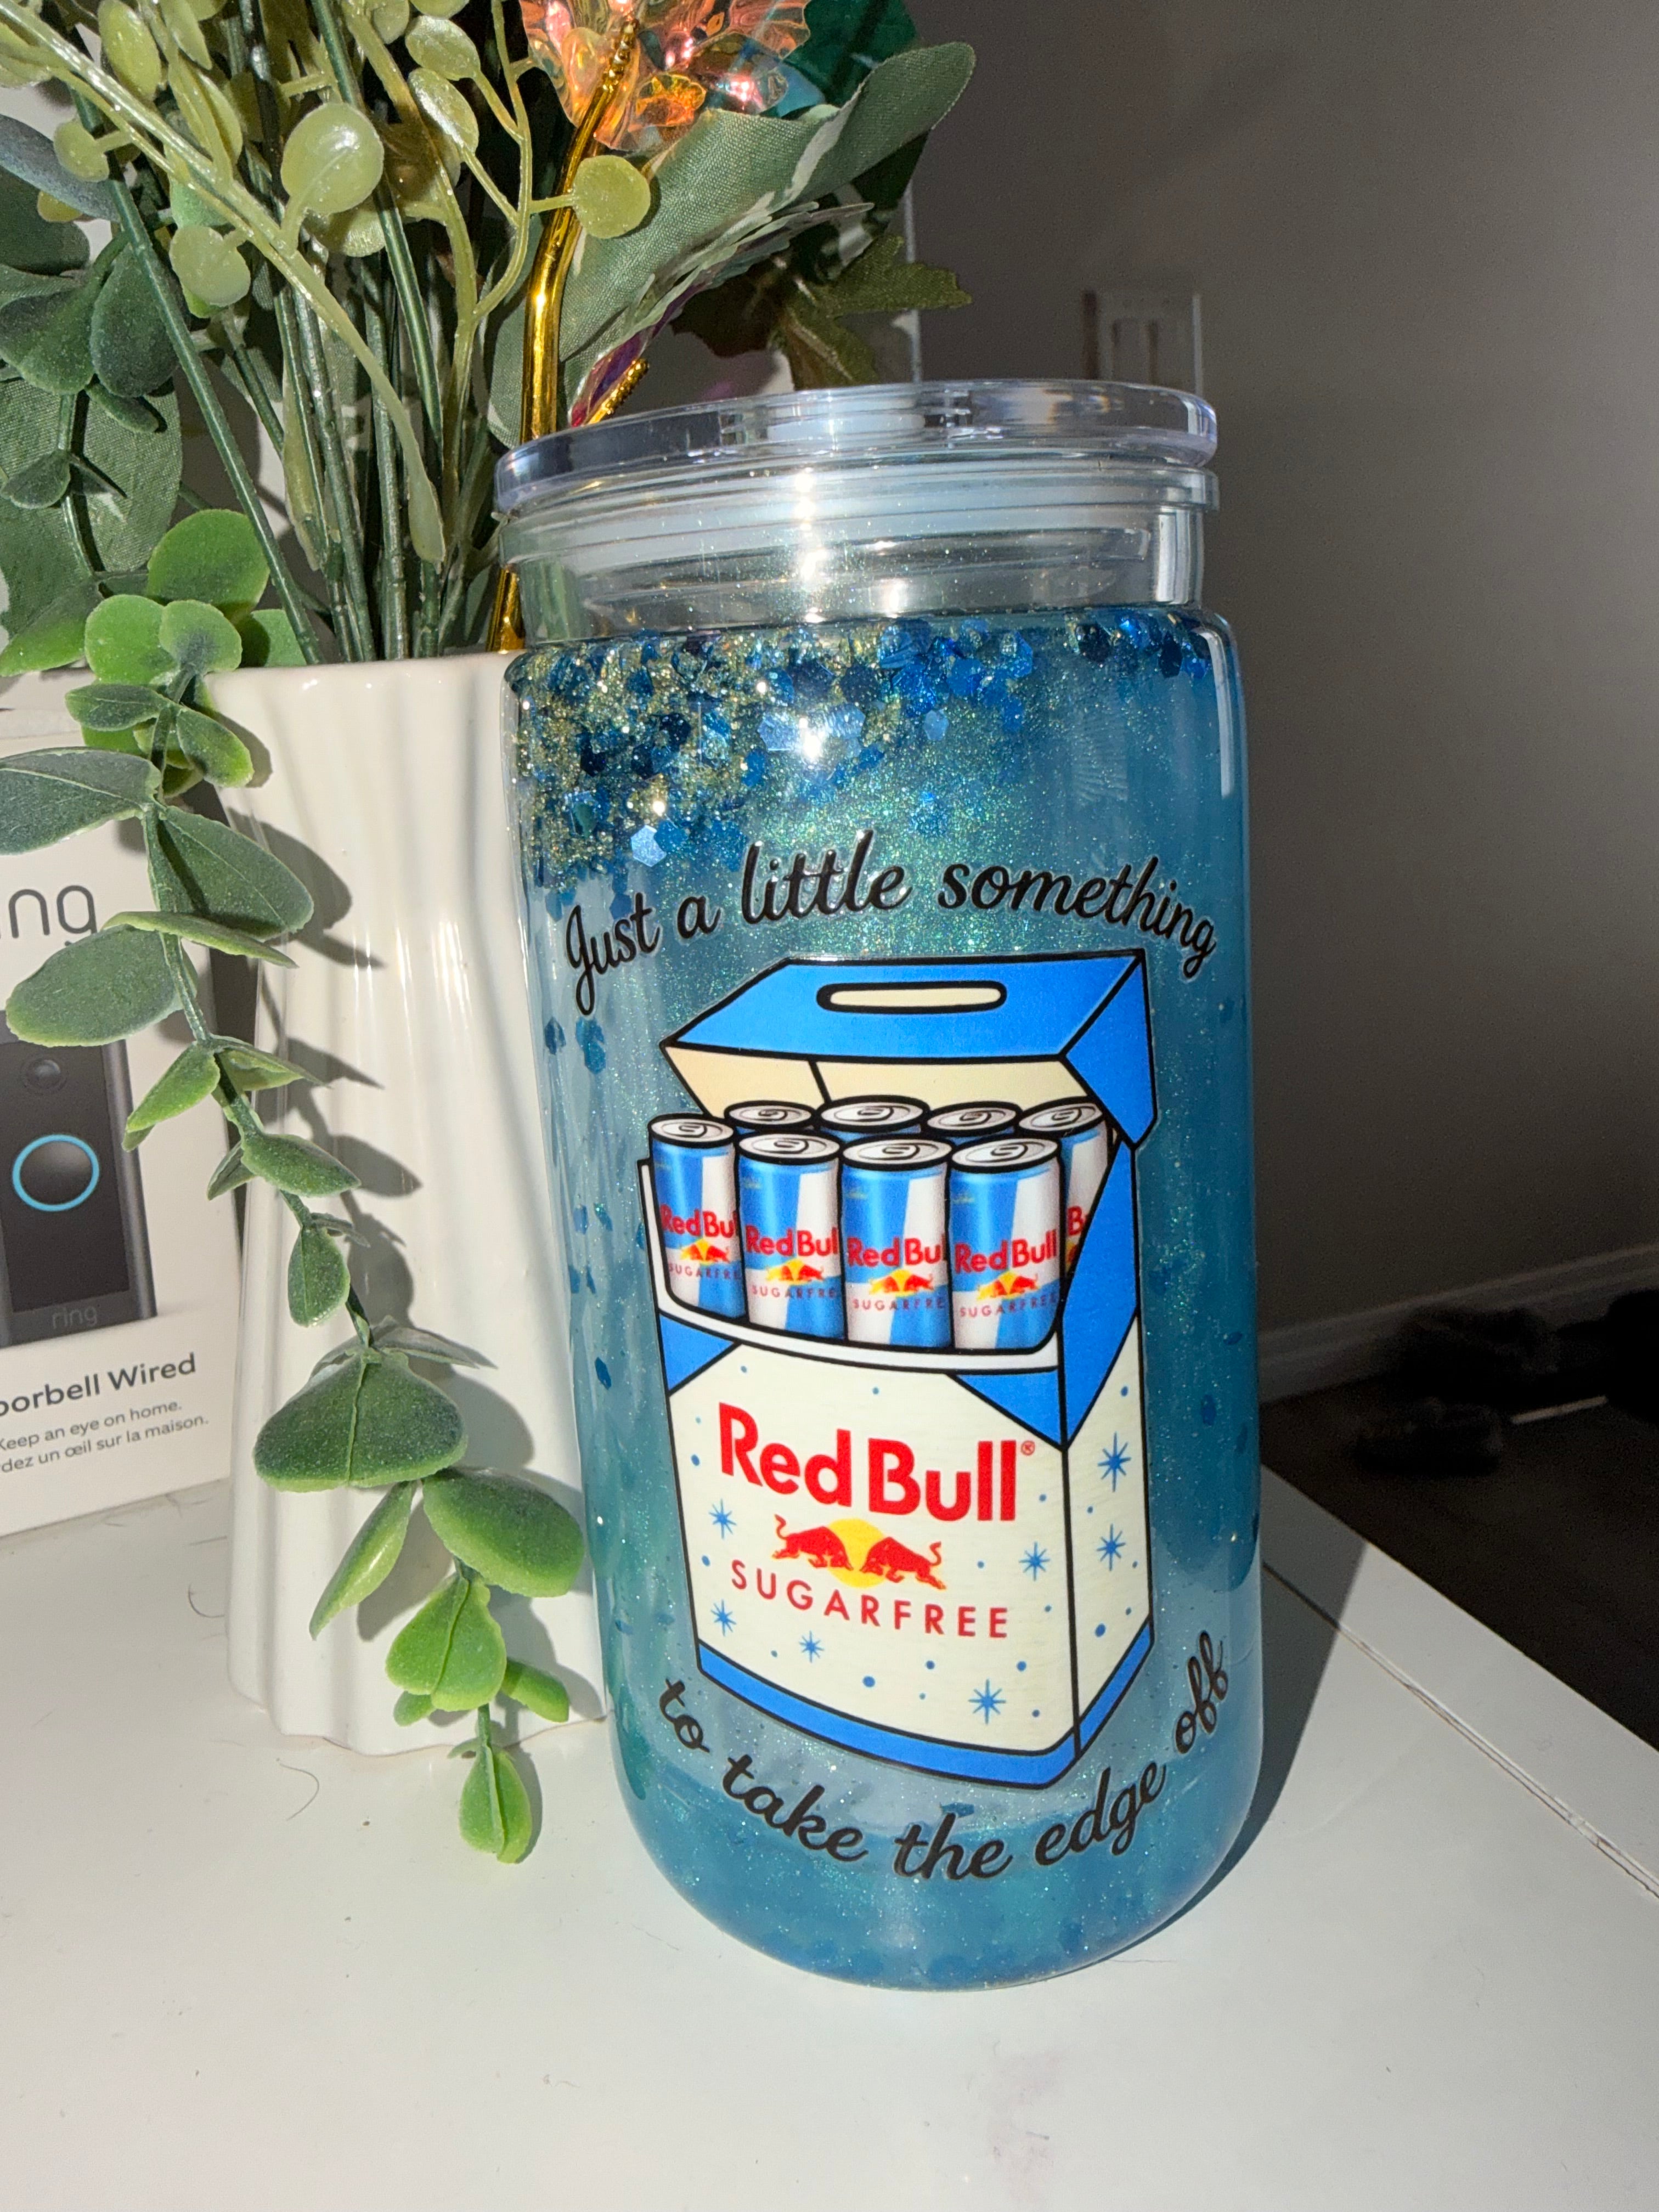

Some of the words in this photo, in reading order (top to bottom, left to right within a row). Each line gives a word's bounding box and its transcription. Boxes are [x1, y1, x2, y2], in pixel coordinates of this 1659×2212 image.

[0, 884, 98, 947] ng
[566, 893, 660, 1015] Just
[678, 895, 721, 939] a
[742, 830, 912, 924] little
[938, 856, 1216, 979] something
[660, 1204, 701, 1237] Red
[746, 1224, 794, 1256] Red
[797, 1227, 838, 1256] Bul
[847, 1237, 900, 1267] Red
[955, 1240, 1008, 1273] Red
[1012, 1229, 1057, 1268] Bull
[52, 1306, 98, 1329] ring
[108, 1352, 196, 1392] Wired
[45, 1427, 65, 1441] an
[70, 1418, 100, 1436] eye
[104, 1413, 125, 1427] on
[130, 1400, 182, 1420] home.
[0, 1458, 33, 1473] dez
[38, 1451, 60, 1464] un
[97, 1434, 122, 1451] sur
[126, 1430, 141, 1443] la
[145, 1414, 209, 1438] maison.
[719, 1402, 851, 1508] Red
[731, 1559, 1008, 1638] SUGARFREE
[659, 1678, 710, 1753] to
[723, 1754, 868, 1862] take
[893, 1812, 1013, 1881] the
[1035, 1762, 1167, 1866] edge
[1175, 1630, 1229, 1754] off
